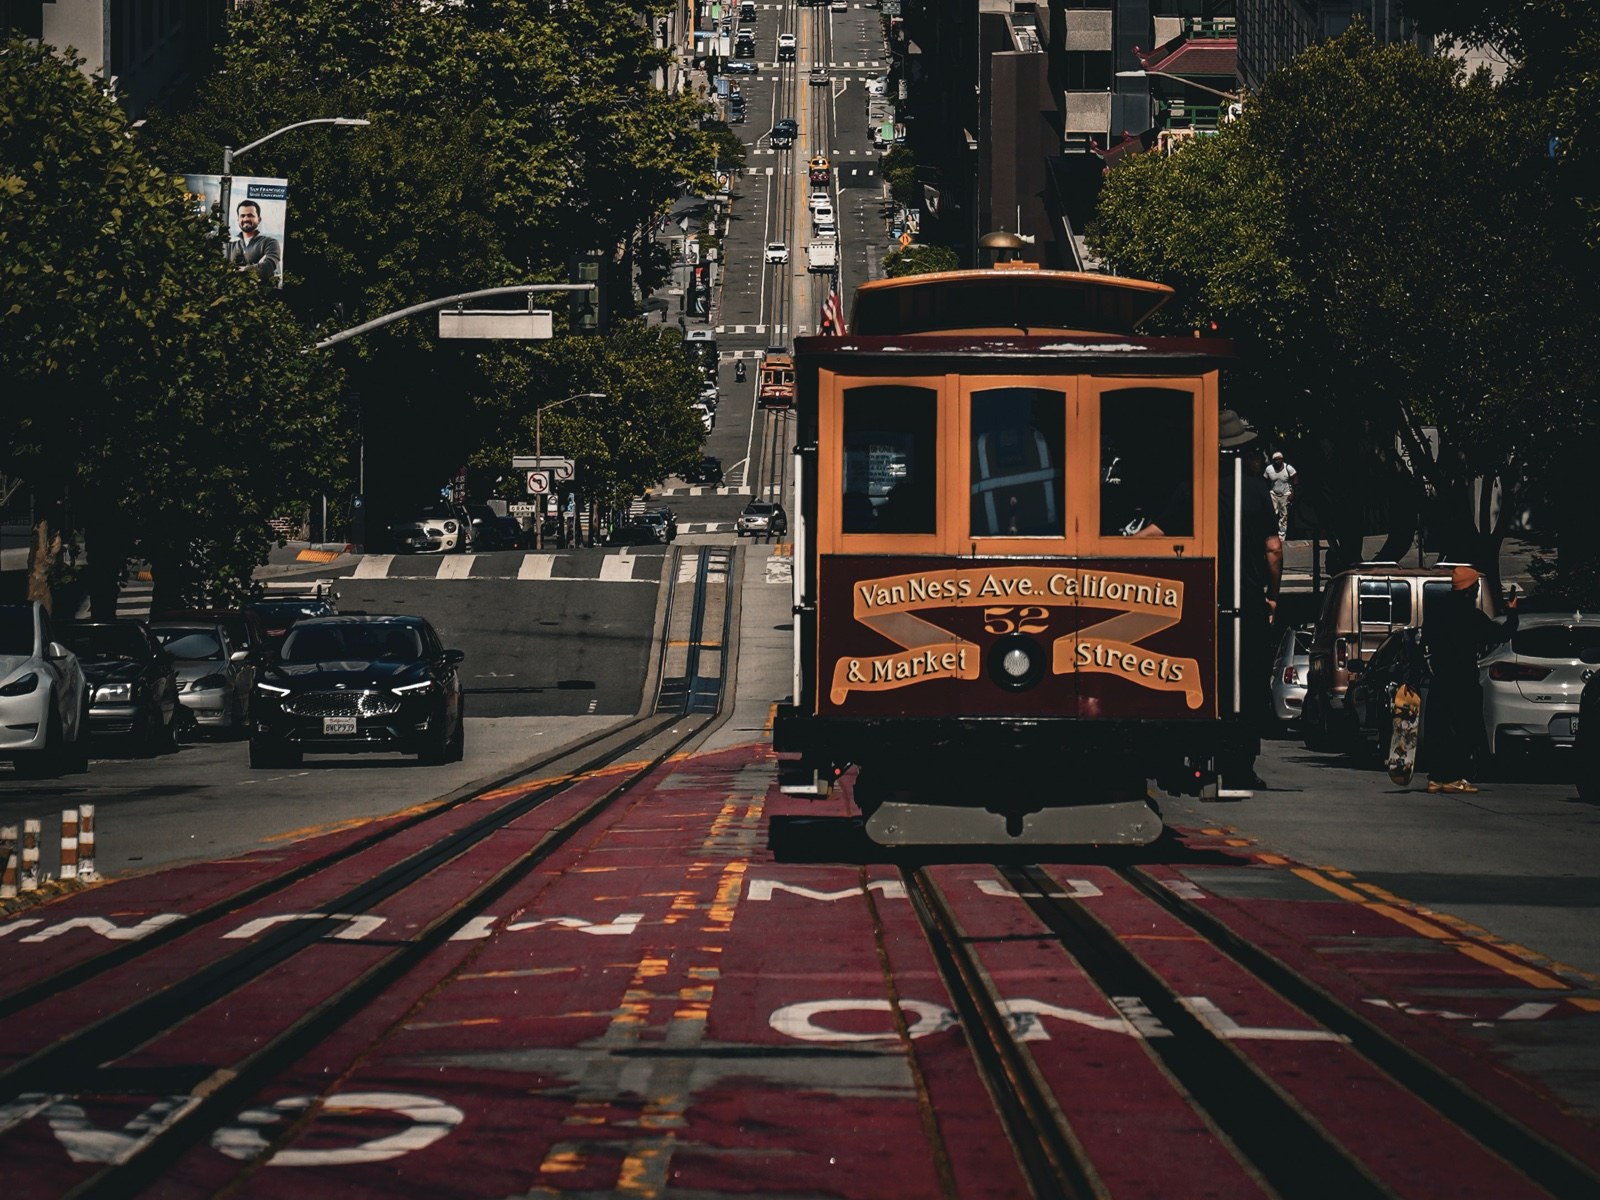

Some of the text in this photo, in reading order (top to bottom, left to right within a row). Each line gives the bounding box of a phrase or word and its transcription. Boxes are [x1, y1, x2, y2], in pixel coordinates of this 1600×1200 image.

[860, 584, 905, 608] Van
[907, 576, 972, 603] Ness
[1048, 572, 1178, 608] California
[984, 606, 1050, 635] 52
[847, 648, 967, 684] & Market
[1074, 642, 1185, 683] Streets
